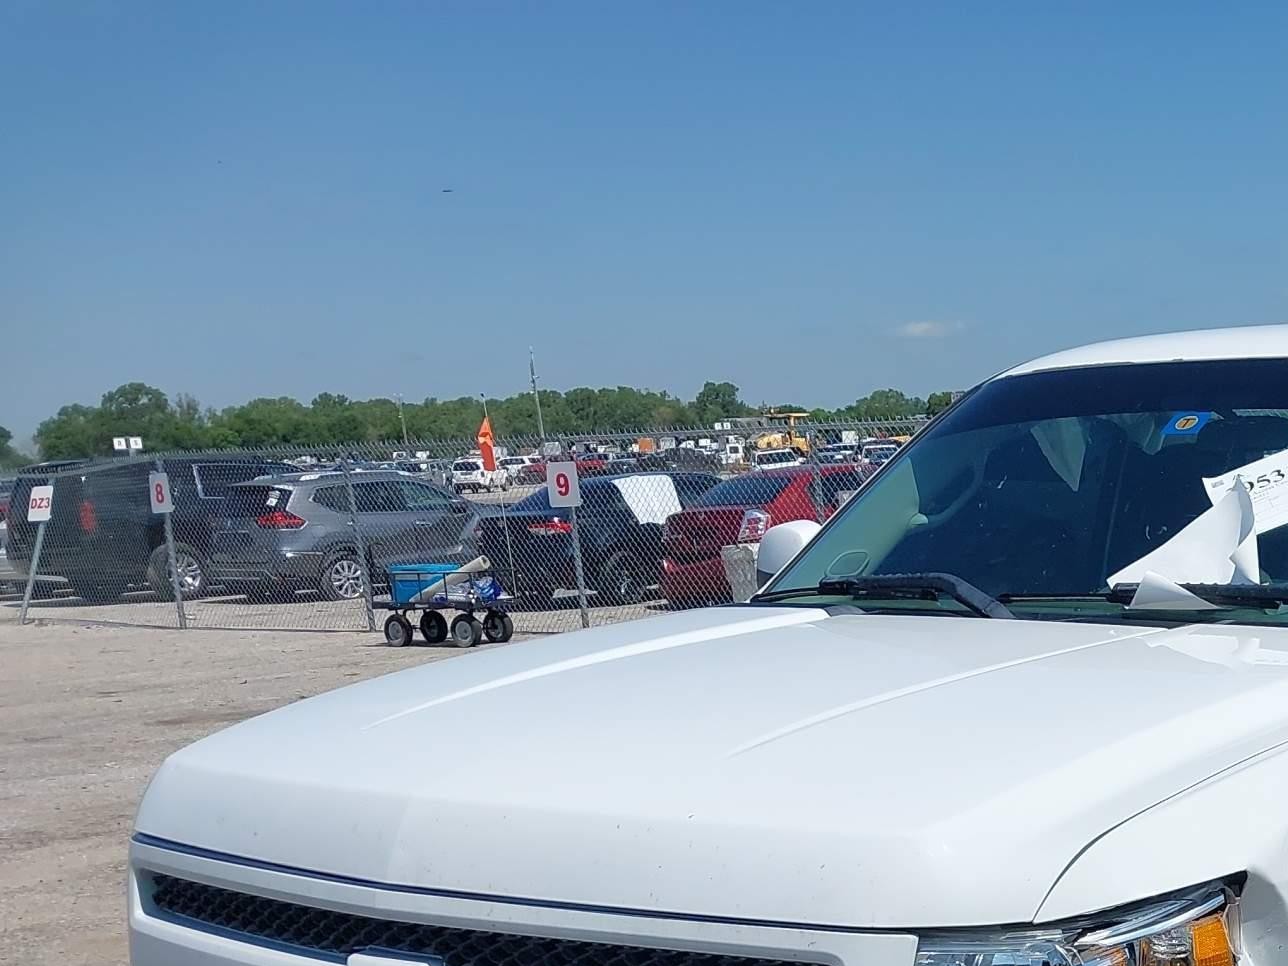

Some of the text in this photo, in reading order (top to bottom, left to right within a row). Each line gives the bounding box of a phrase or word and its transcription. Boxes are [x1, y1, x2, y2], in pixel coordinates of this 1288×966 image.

[155, 483, 165, 503] 8
[556, 473, 570, 496] 9
[31, 497, 50, 509] DZ3
